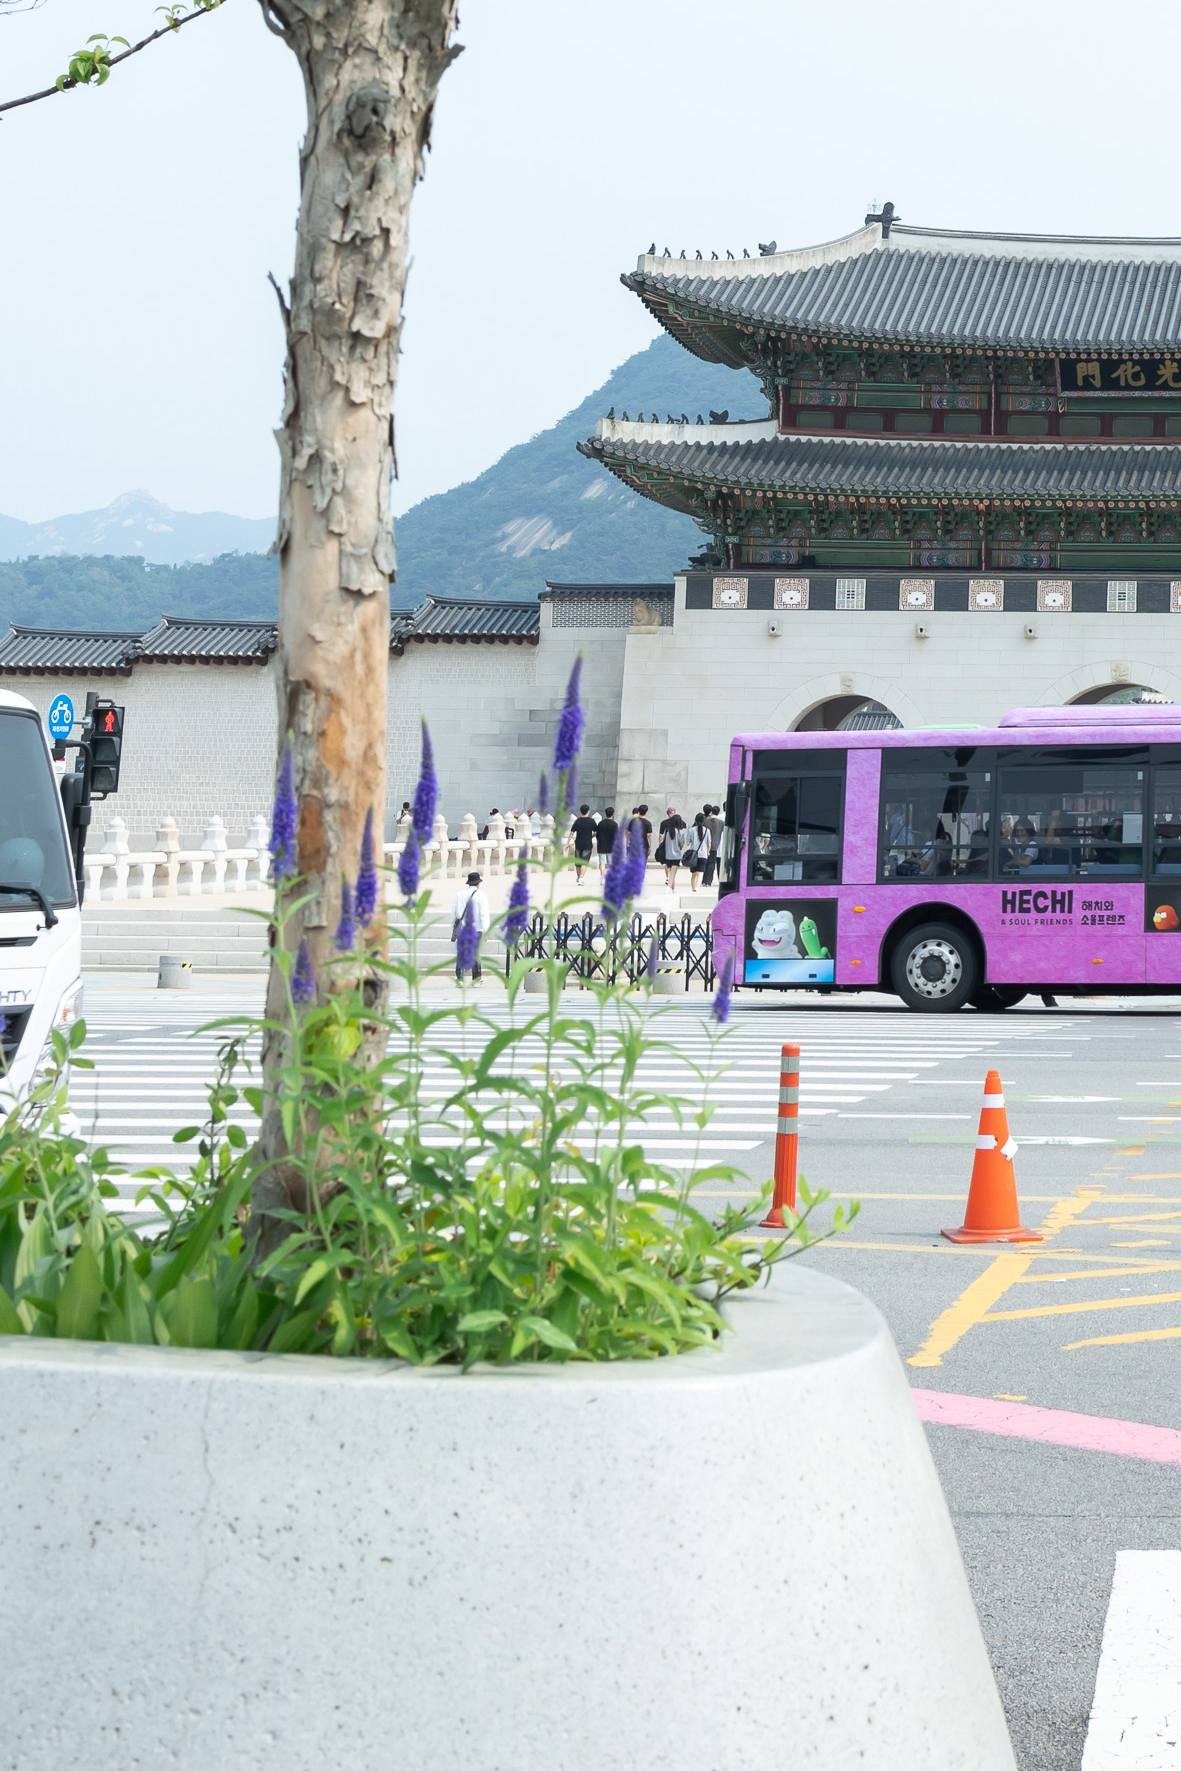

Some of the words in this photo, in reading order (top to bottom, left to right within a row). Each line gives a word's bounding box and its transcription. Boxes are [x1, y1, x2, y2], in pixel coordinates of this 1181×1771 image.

[1001, 889, 1074, 914] HECHI
[1081, 900, 1115, 912] 해치와
[1008, 918, 1032, 926] SOUL
[1034, 918, 1074, 926] FRIENDS
[1081, 914, 1126, 926] 소울프렌즈
